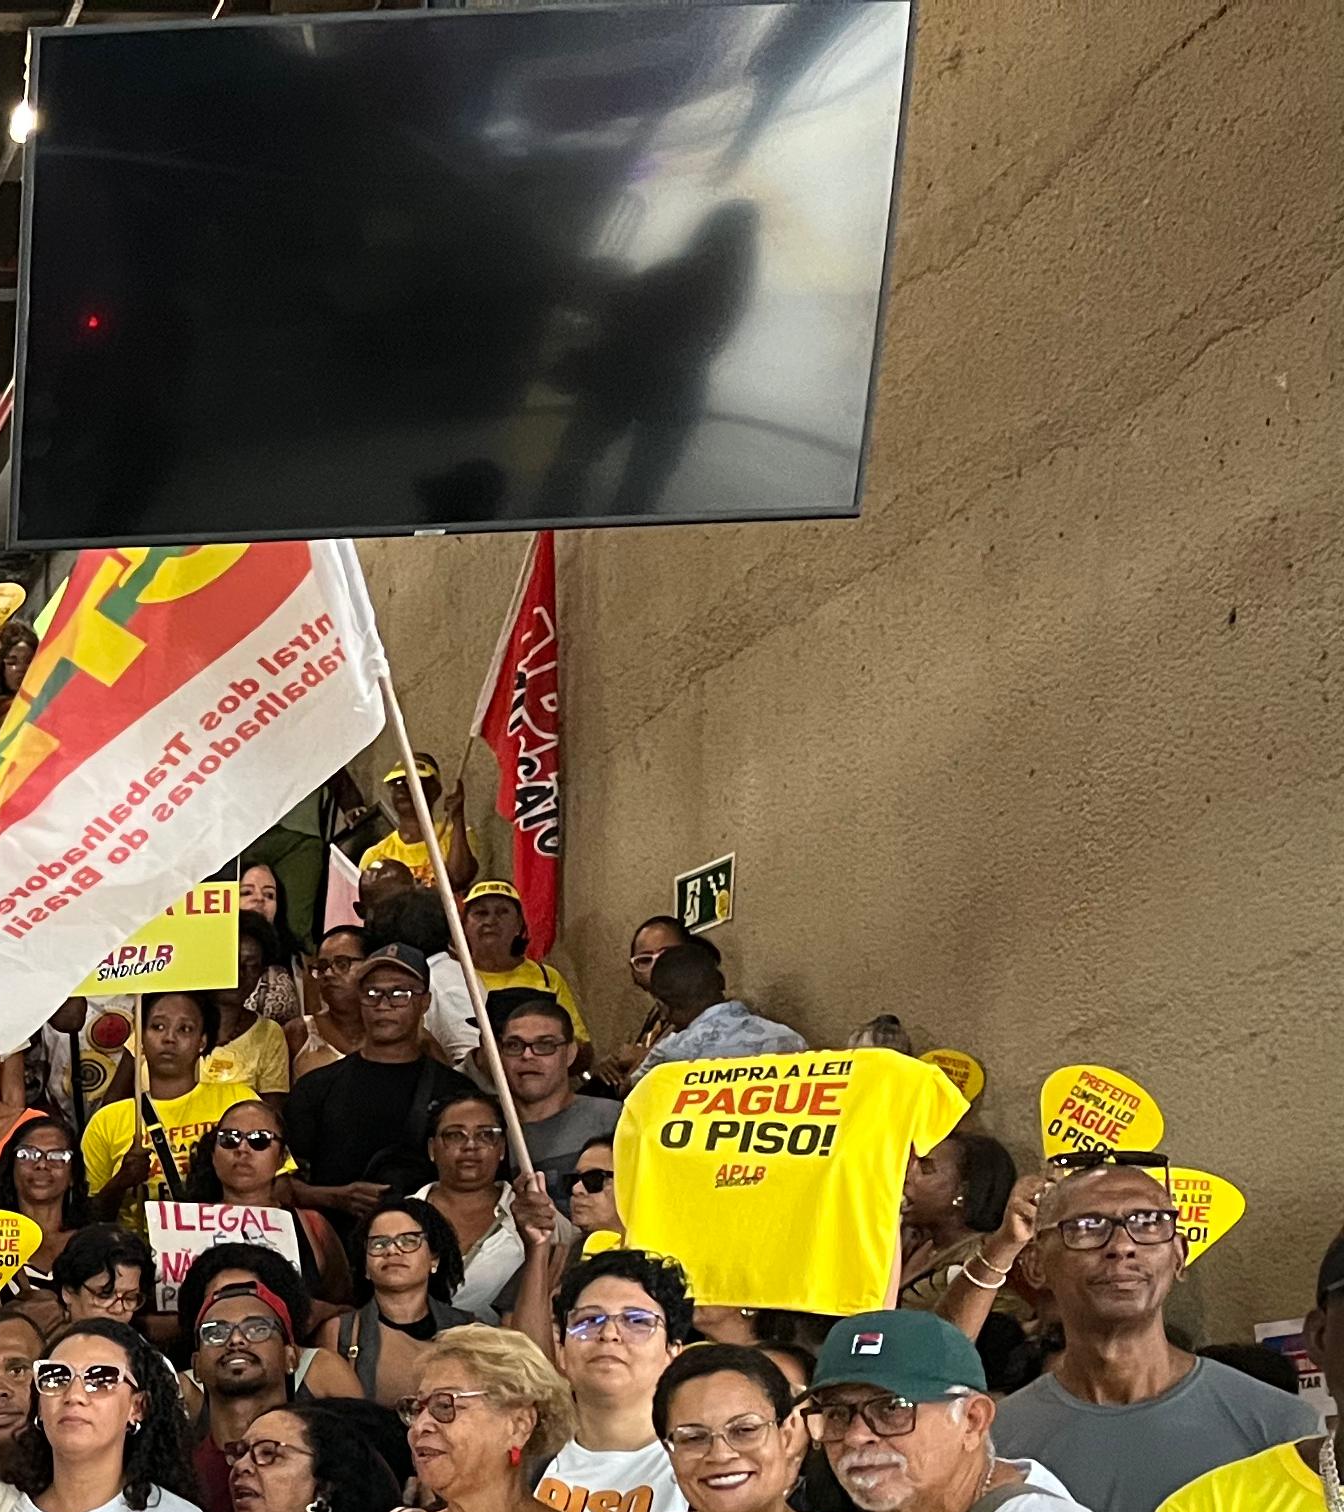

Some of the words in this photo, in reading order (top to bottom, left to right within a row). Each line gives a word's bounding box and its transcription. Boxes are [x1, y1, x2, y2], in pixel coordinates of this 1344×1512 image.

[186, 889, 231, 915] LEI
[97, 959, 165, 981] SINDICATO
[684, 1066, 777, 1086] CUMPRA
[783, 1064, 800, 1078] A
[812, 1060, 853, 1076] LEI!
[672, 1082, 848, 1116] PAGUE
[660, 1120, 693, 1149] O
[704, 1121, 836, 1156] PISO!
[158, 1201, 283, 1233] ILEGAL
